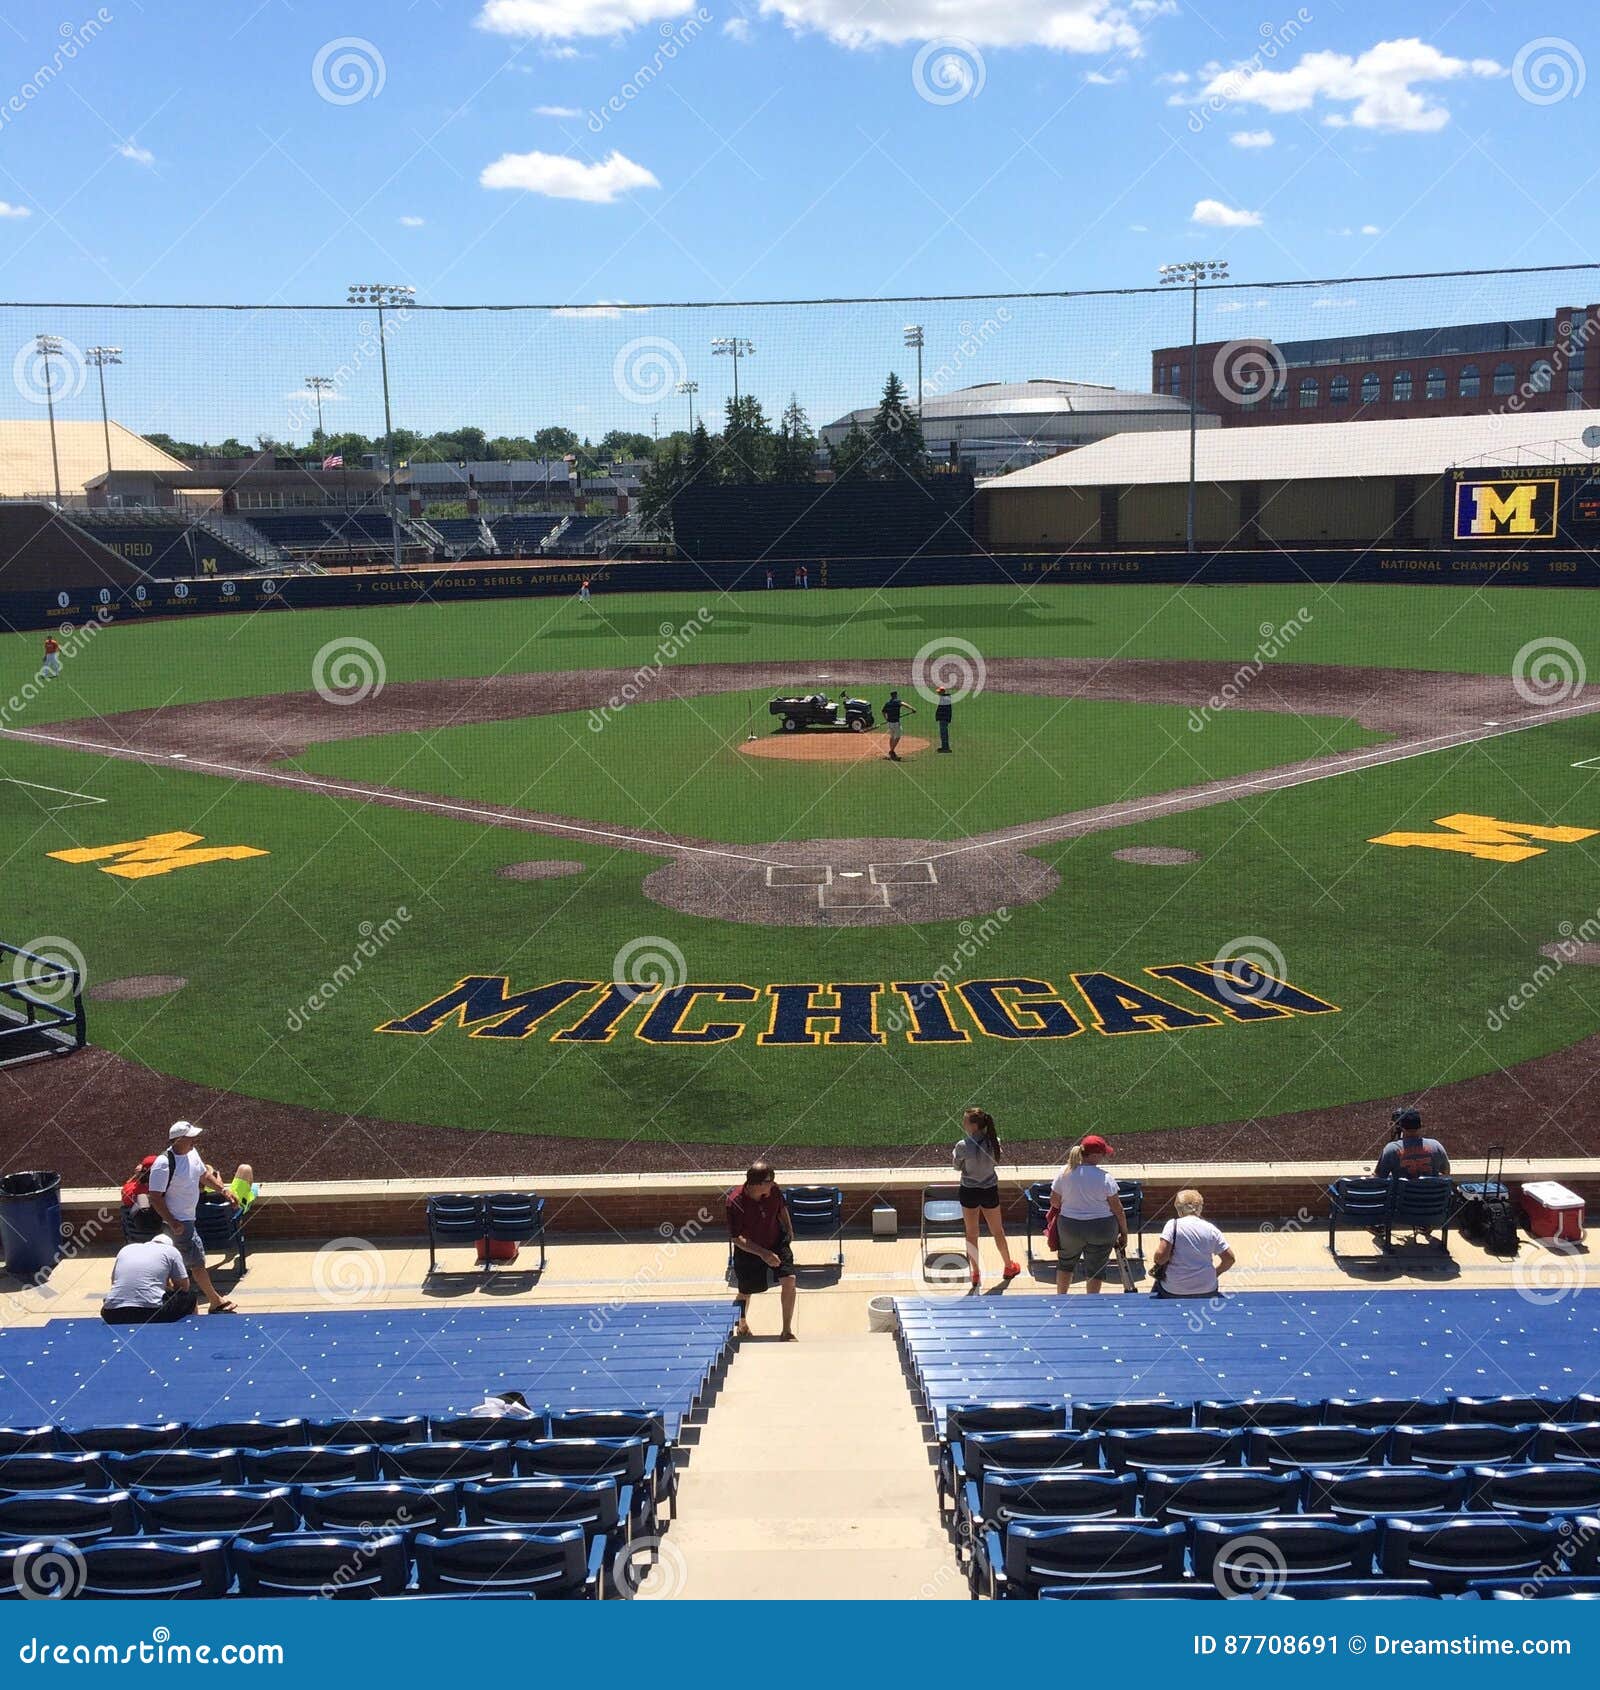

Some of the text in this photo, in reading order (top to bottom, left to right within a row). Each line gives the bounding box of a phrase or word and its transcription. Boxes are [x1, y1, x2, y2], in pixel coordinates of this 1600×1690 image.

[1501, 467, 1586, 479] UNIVERSITY
[1470, 485, 1537, 534] M
[125, 543, 152, 556] FIELD
[202, 558, 217, 573] M
[1070, 562, 1092, 571] TEN
[1100, 562, 1140, 571] TITLES
[1381, 559, 1577, 572] NATIONAL CHAMPIONS 1953
[371, 580, 425, 591] COLLEGE
[434, 577, 477, 588] WORLD
[484, 576, 523, 586] SERIES
[530, 571, 611, 584] APPEARANCES
[1365, 813, 1600, 863] M
[46, 831, 271, 879] M
[374, 957, 1343, 1046] MICHIGAN
